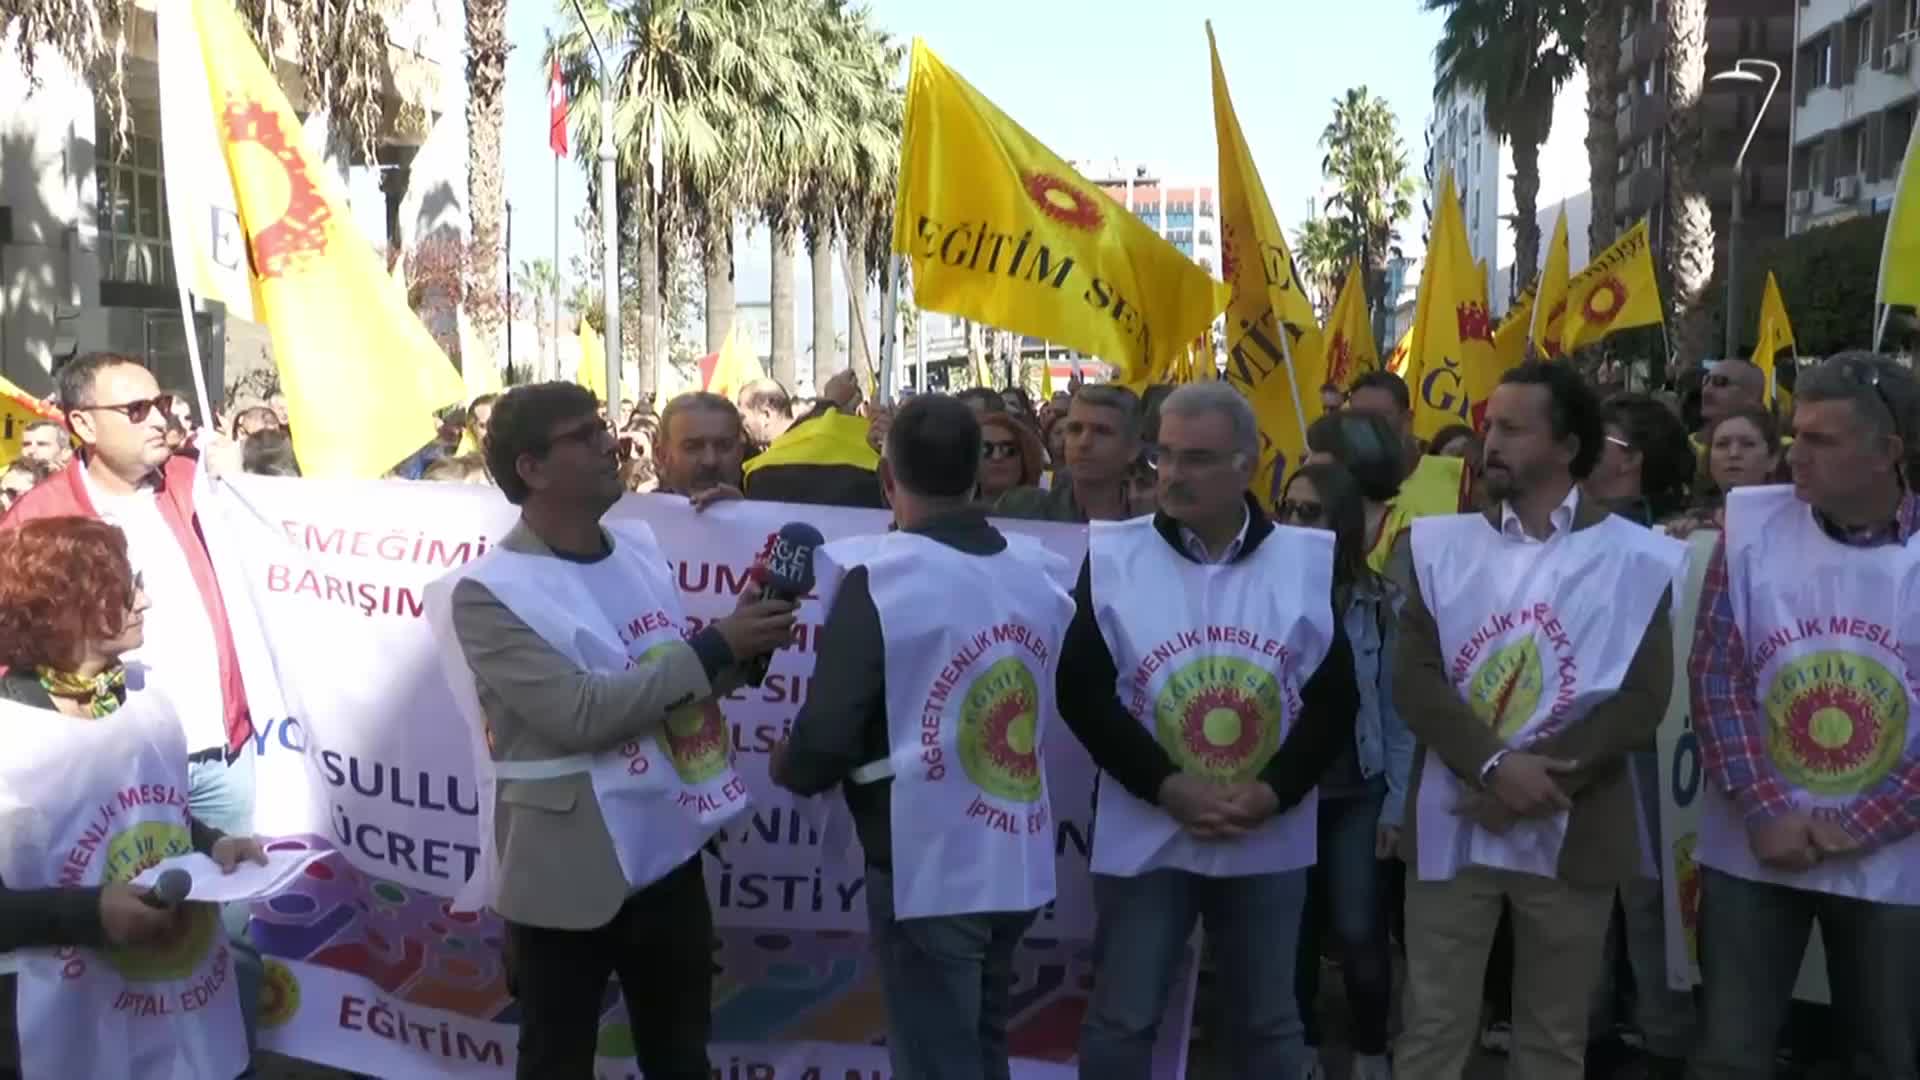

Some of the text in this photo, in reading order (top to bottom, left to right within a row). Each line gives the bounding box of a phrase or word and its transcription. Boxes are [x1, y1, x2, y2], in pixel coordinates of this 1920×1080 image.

[918, 216, 1075, 288] EĞİTİM
[267, 563, 424, 618] BARIŞIM
[1207, 624, 1290, 665] MESLEK
[338, 994, 504, 1067] EĞİTİM
